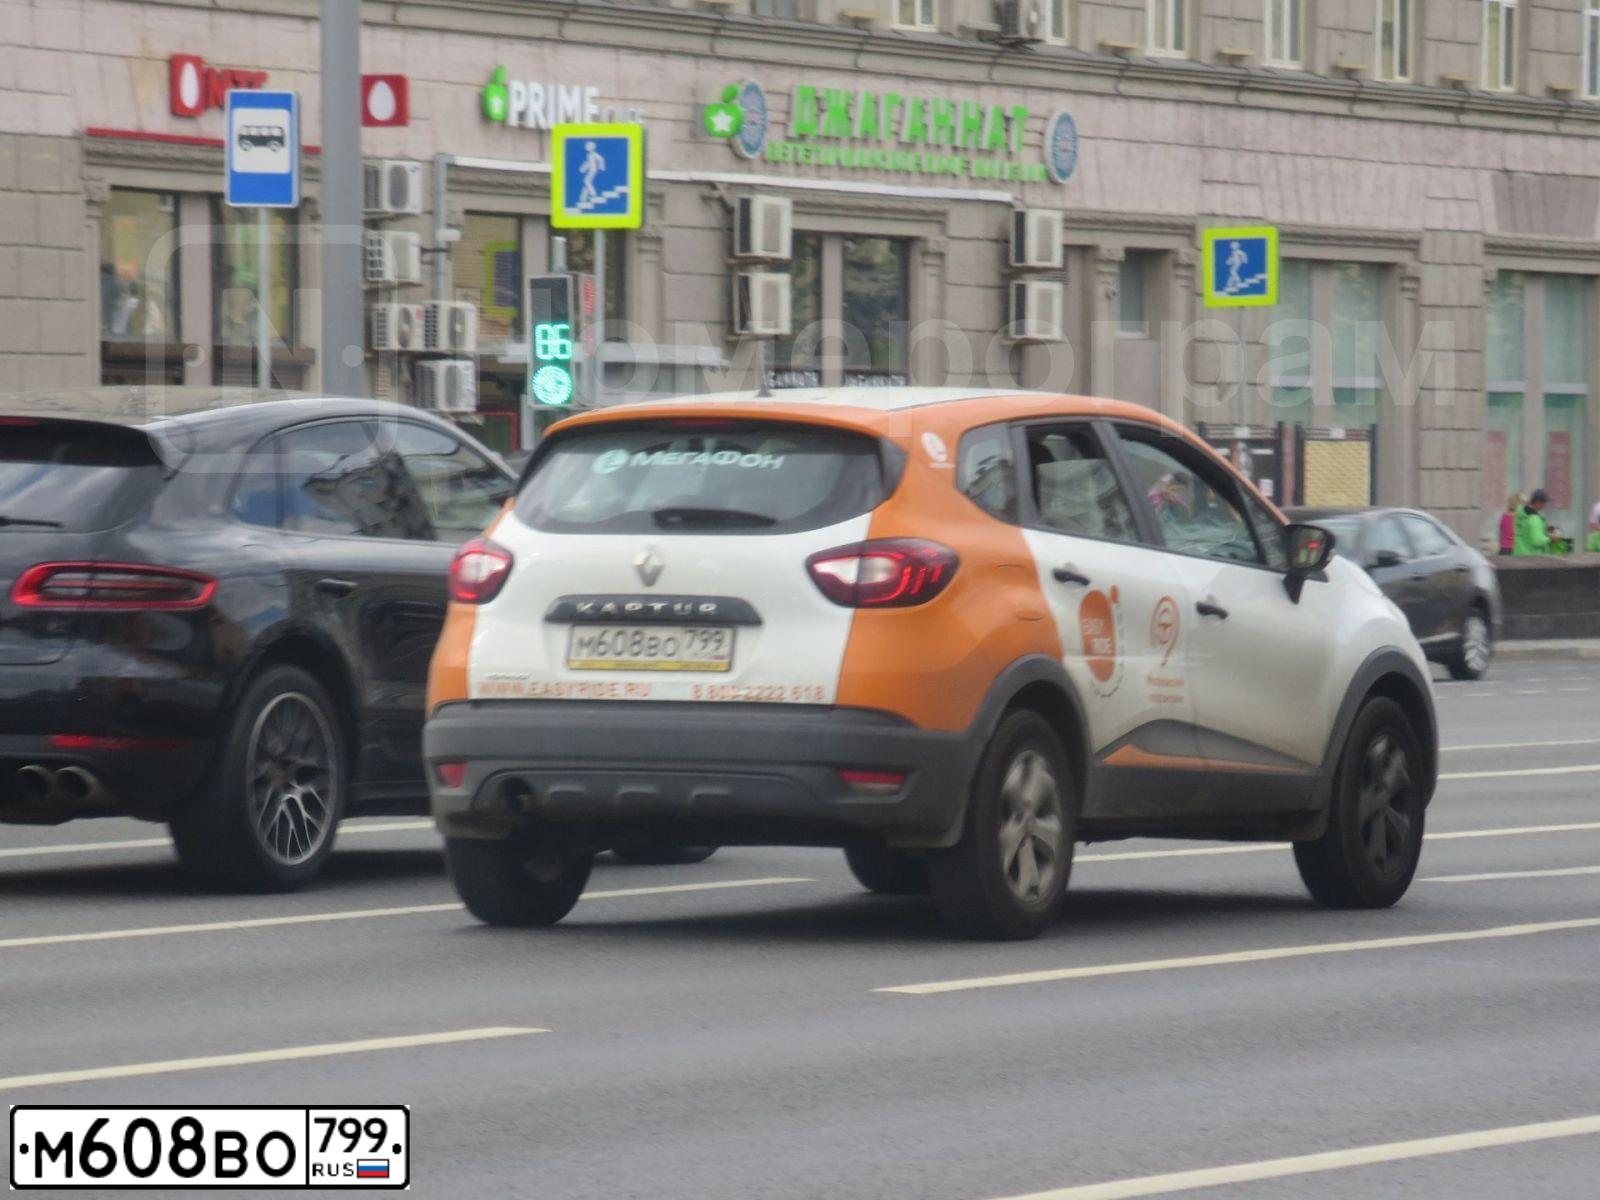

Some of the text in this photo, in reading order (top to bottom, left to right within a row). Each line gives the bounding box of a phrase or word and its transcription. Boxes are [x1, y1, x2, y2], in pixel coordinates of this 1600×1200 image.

[506, 79, 600, 130] PRIME
[793, 85, 1029, 152] ДЖАГАННАТ
[629, 450, 785, 470] МЕГАФОН
[575, 627, 726, 658] М608ВО 799
